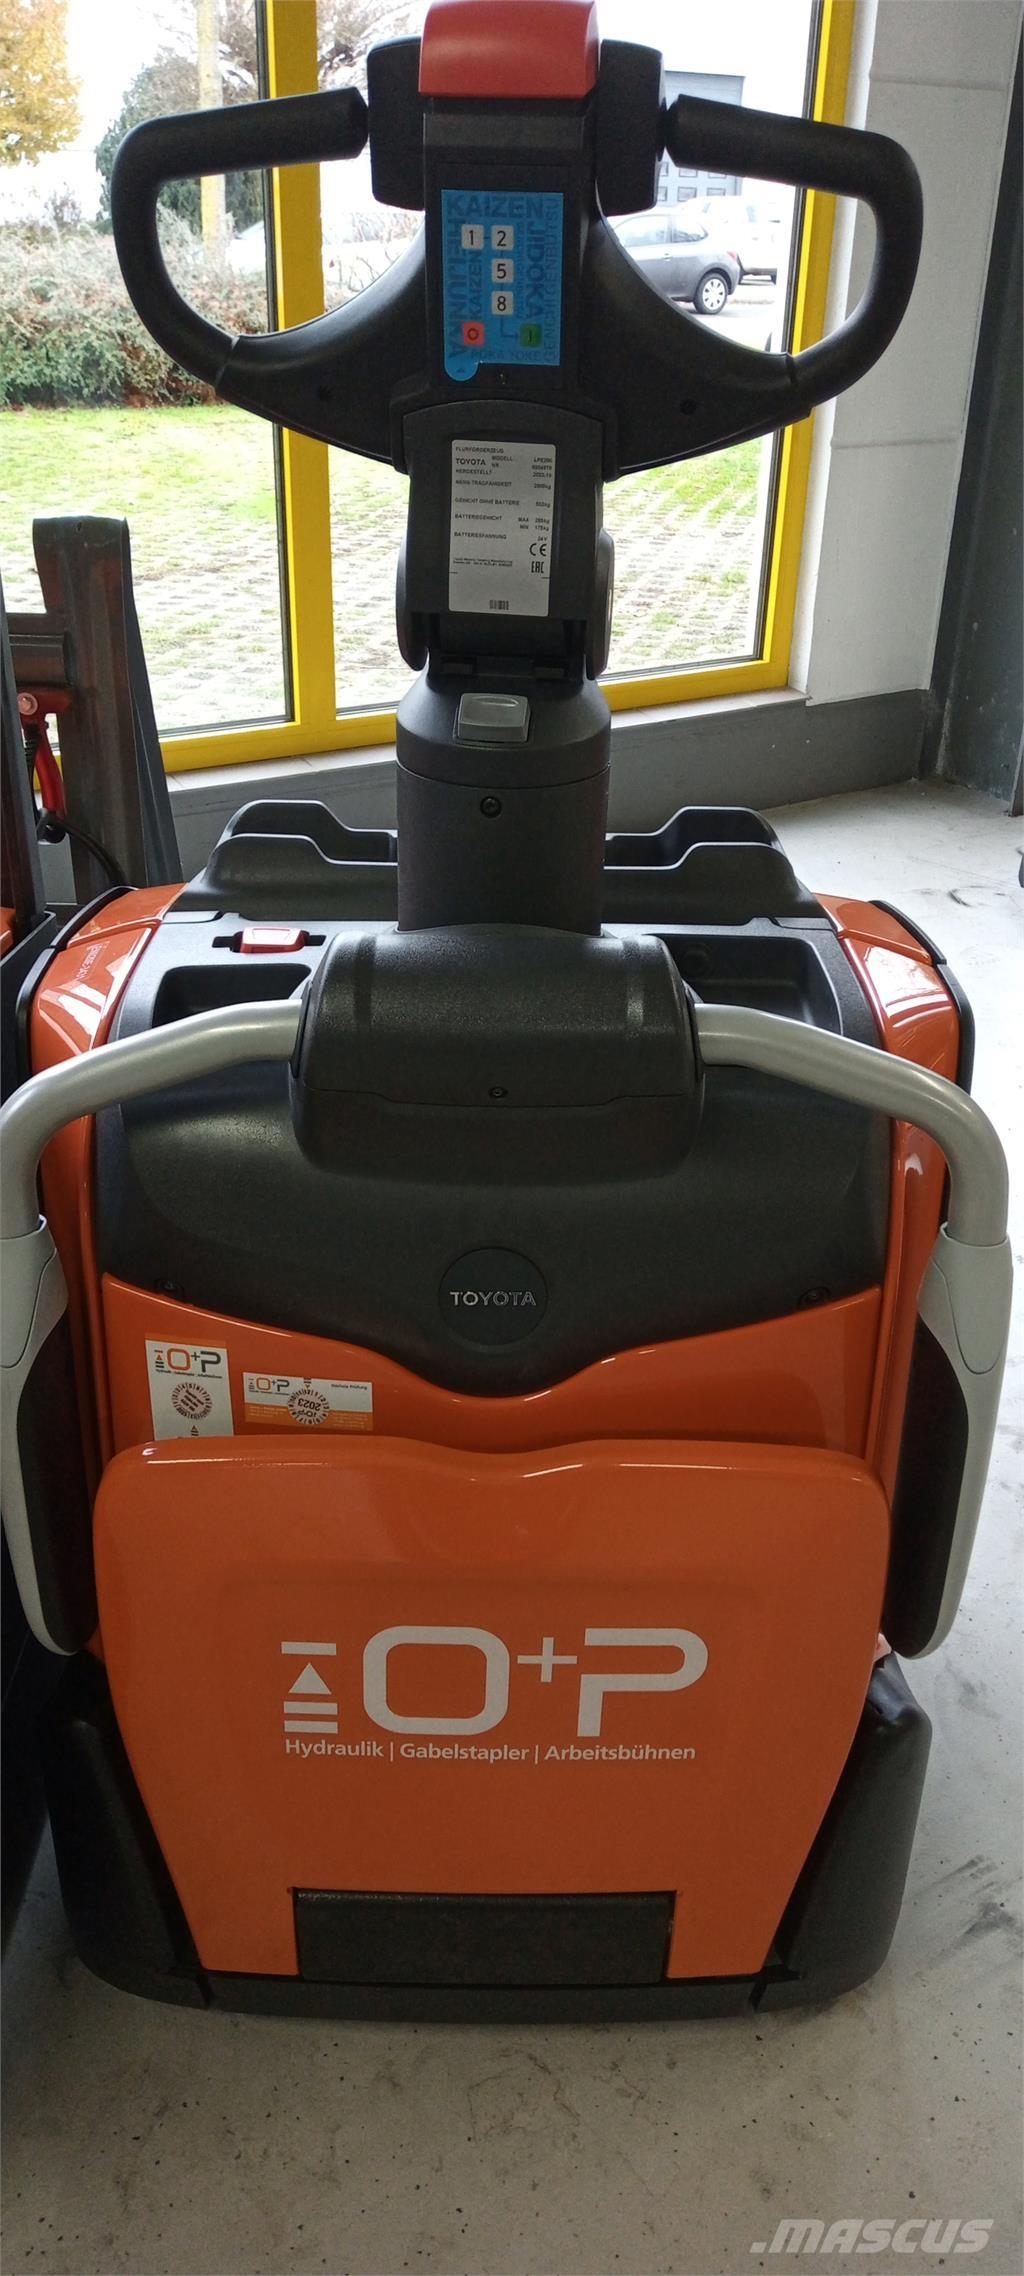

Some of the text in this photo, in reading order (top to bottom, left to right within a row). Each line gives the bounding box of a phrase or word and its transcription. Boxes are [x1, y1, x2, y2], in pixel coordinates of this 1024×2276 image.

[446, 194, 544, 219] KAIZEN
[497, 230, 506, 247] 2
[497, 264, 506, 279] 5
[526, 222, 545, 319] JIDOKA
[497, 295, 506, 312] 8
[455, 458, 486, 466] TOYOTA
[529, 543, 547, 557] CE
[449, 1290, 537, 1306] TOYOTA
[297, 1397, 322, 1412] 2023
[285, 1738, 696, 1764] Hydraulik Gabelstapler Arbeitsbühnen
